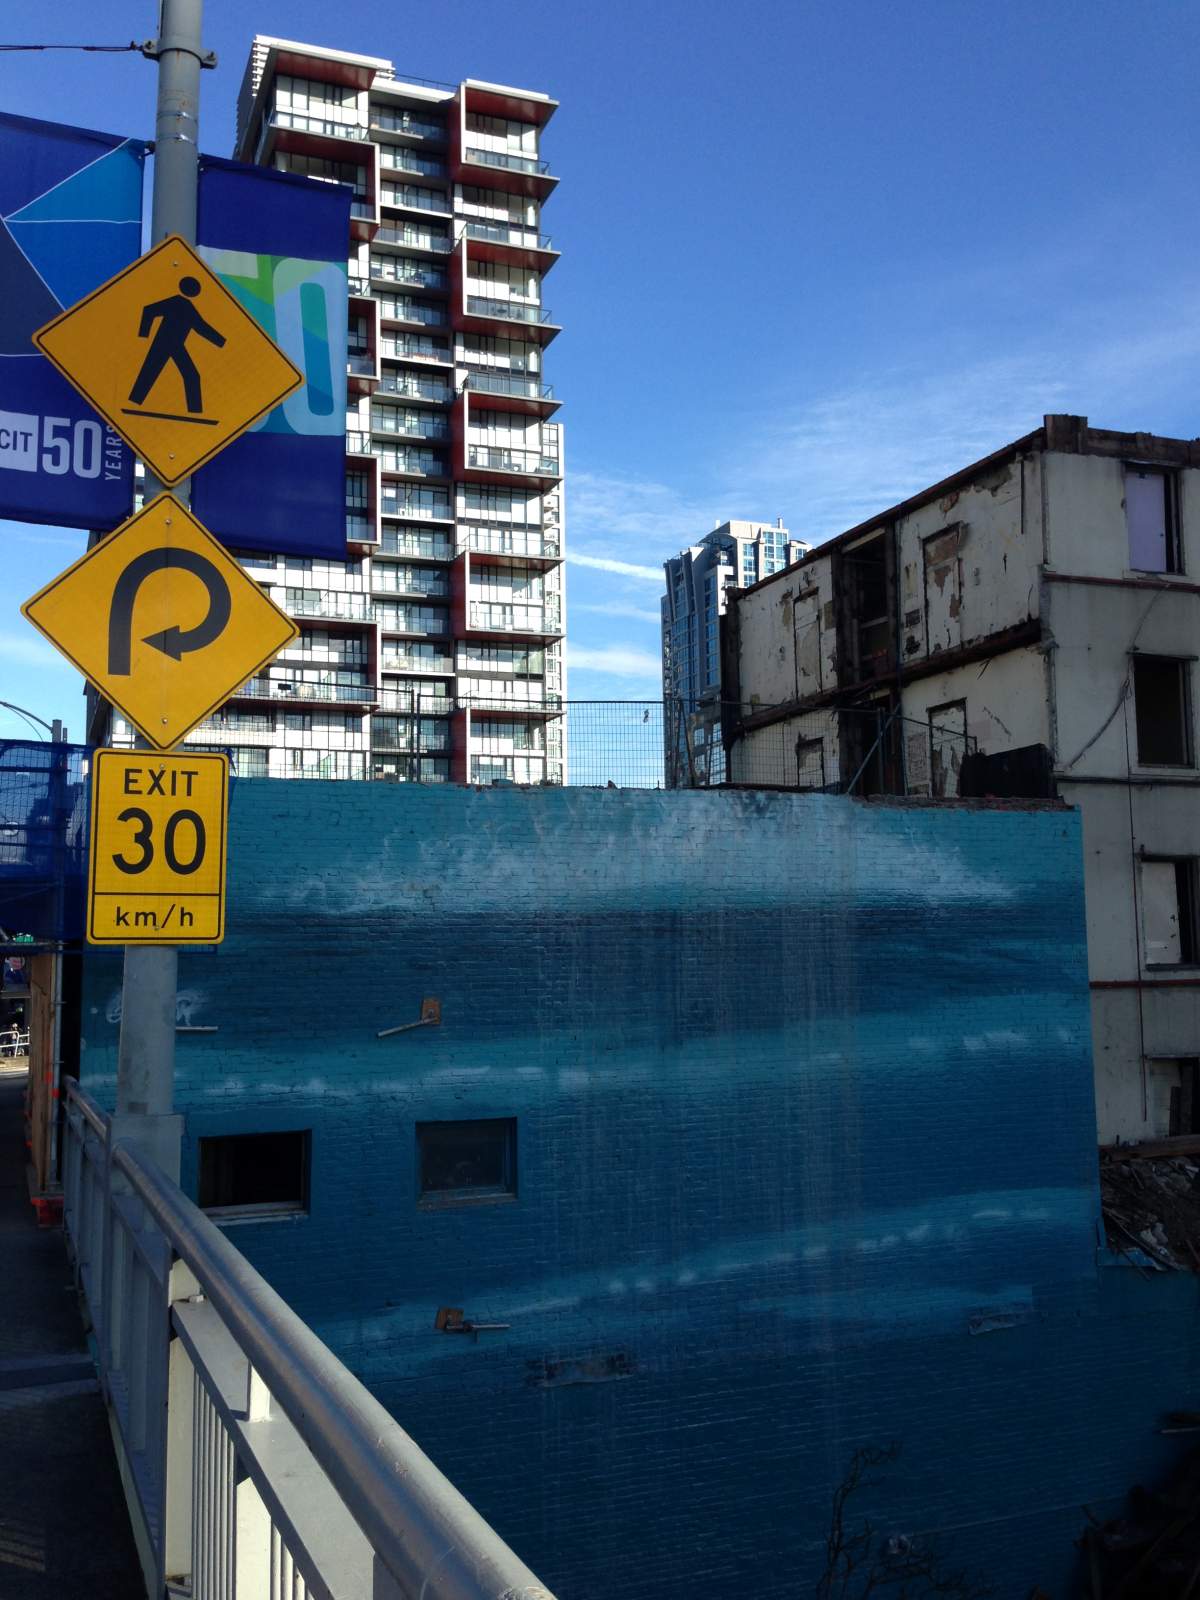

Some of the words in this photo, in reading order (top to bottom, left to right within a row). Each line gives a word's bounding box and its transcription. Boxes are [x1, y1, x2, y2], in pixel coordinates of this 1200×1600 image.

[42, 416, 102, 479] 50
[124, 768, 199, 797] EXIT
[112, 807, 206, 875] 30
[115, 903, 194, 929] km/h
